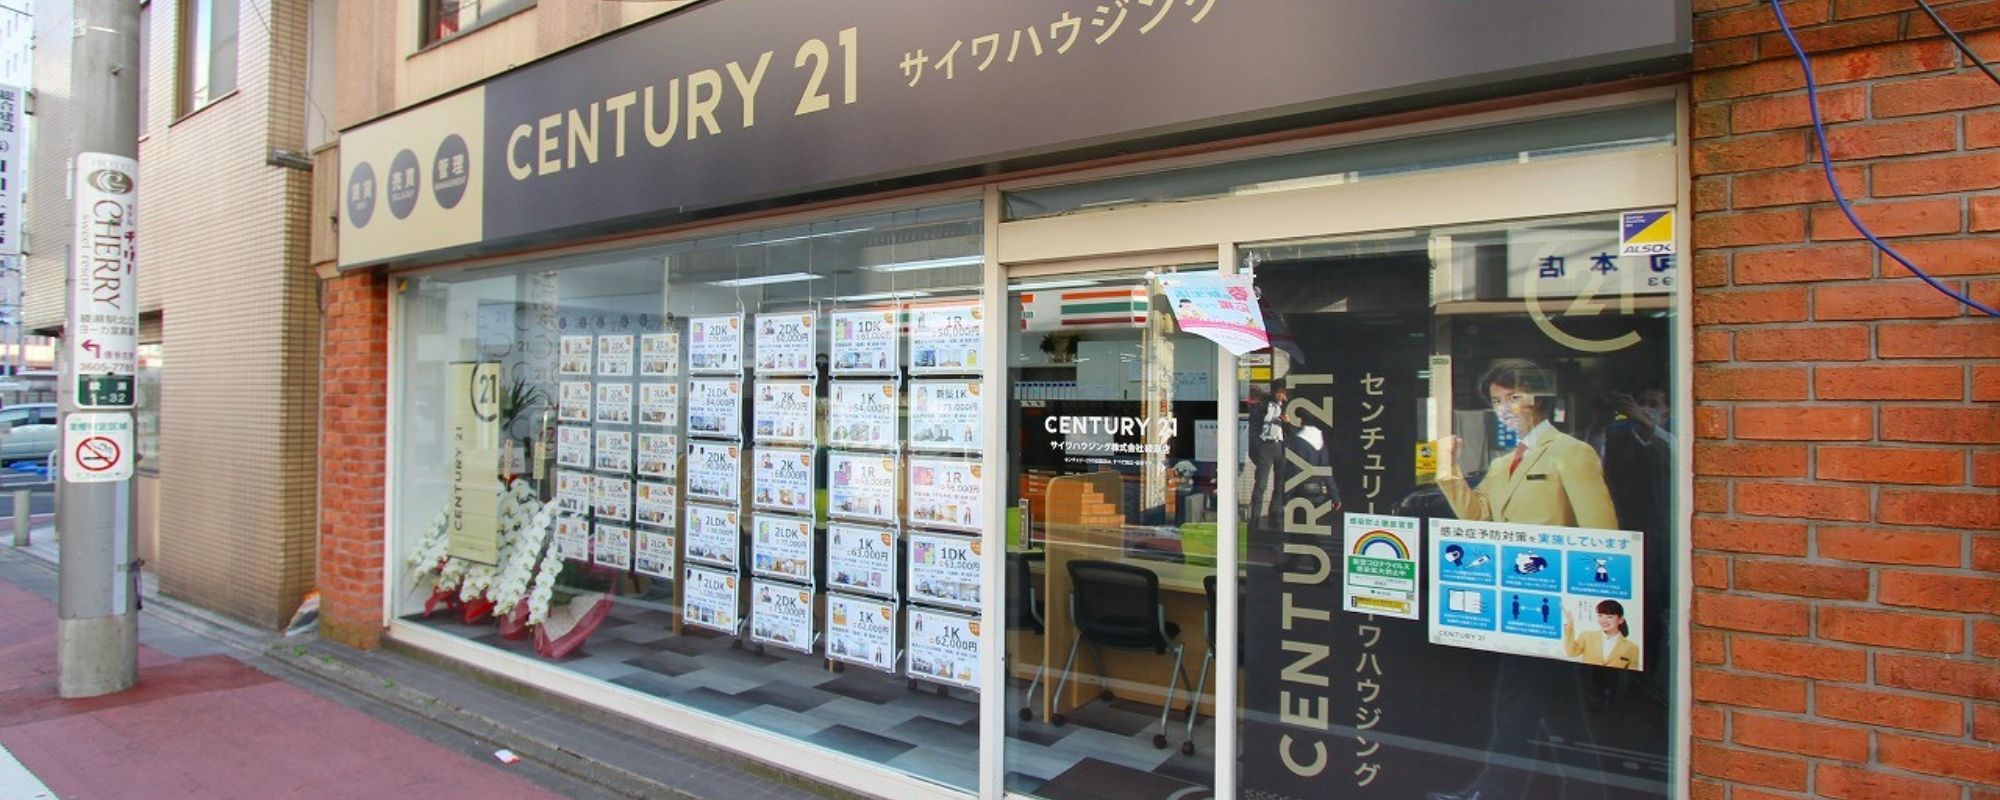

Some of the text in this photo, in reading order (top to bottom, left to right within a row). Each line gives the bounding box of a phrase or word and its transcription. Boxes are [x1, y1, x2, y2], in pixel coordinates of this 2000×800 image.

[506, 27, 857, 181] CENTURY 21
[80, 214, 91, 292] sweet resort
[93, 200, 123, 310] CHERRY
[1624, 244, 1673, 254] ALSOK
[858, 320, 881, 332] 1DK
[945, 315, 962, 329] 1R
[709, 325, 728, 336] 2DK
[779, 323, 801, 335] 2DK
[707, 387, 729, 398] 2LDK
[781, 391, 795, 402] 2K
[861, 392, 876, 405] 1K
[1044, 416, 1177, 438] CENTURY 21
[707, 452, 726, 463] 2DK
[780, 459, 795, 470] 2K
[861, 466, 876, 478] 1R
[945, 471, 962, 483] 1R
[454, 427, 463, 531] CENTURY 21
[705, 516, 727, 527] 2LDK
[774, 526, 799, 539] 2LDK
[858, 538, 873, 551] 1K
[940, 547, 967, 561] 1DK
[1352, 558, 1411, 570] 新型コロナウイルス
[1279, 372, 1335, 778] CENTURY 21
[703, 578, 725, 590] 2LDK
[775, 594, 797, 608] 2DK
[859, 610, 874, 623] 1K
[943, 625, 960, 639] 1K
[1439, 630, 1476, 639] CENTURY
[935, 636, 978, 653] 62,000円
